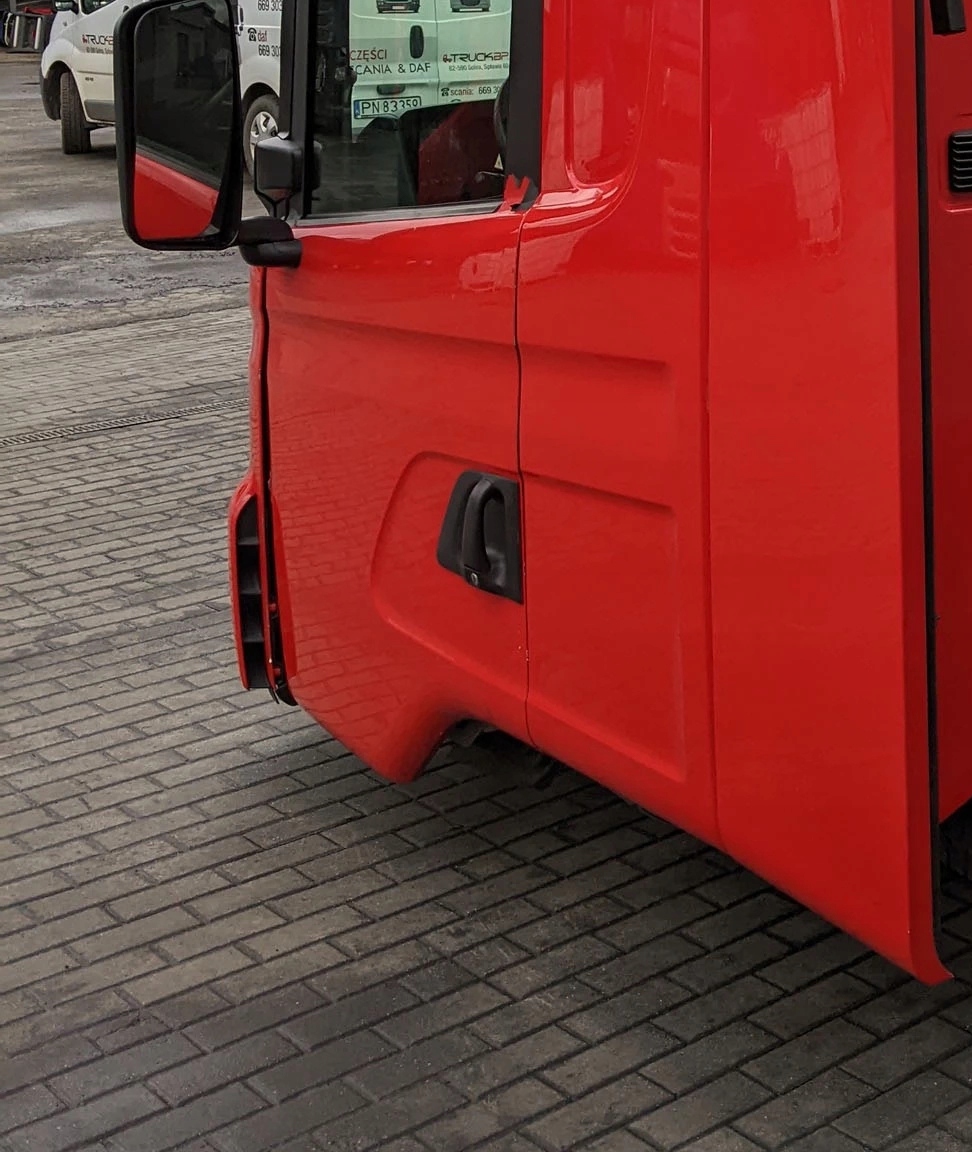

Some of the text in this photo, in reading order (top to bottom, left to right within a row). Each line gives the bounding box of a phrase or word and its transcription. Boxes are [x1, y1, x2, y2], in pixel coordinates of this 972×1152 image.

[257, 0, 270, 12] 669
[257, 30, 268, 42] daf
[258, 44, 271, 57] 669
[350, 47, 388, 62] CZĘŚCI
[397, 63, 406, 74] &
[409, 62, 431, 73] DAF
[478, 86, 492, 95] 669
[361, 100, 380, 115] PN
